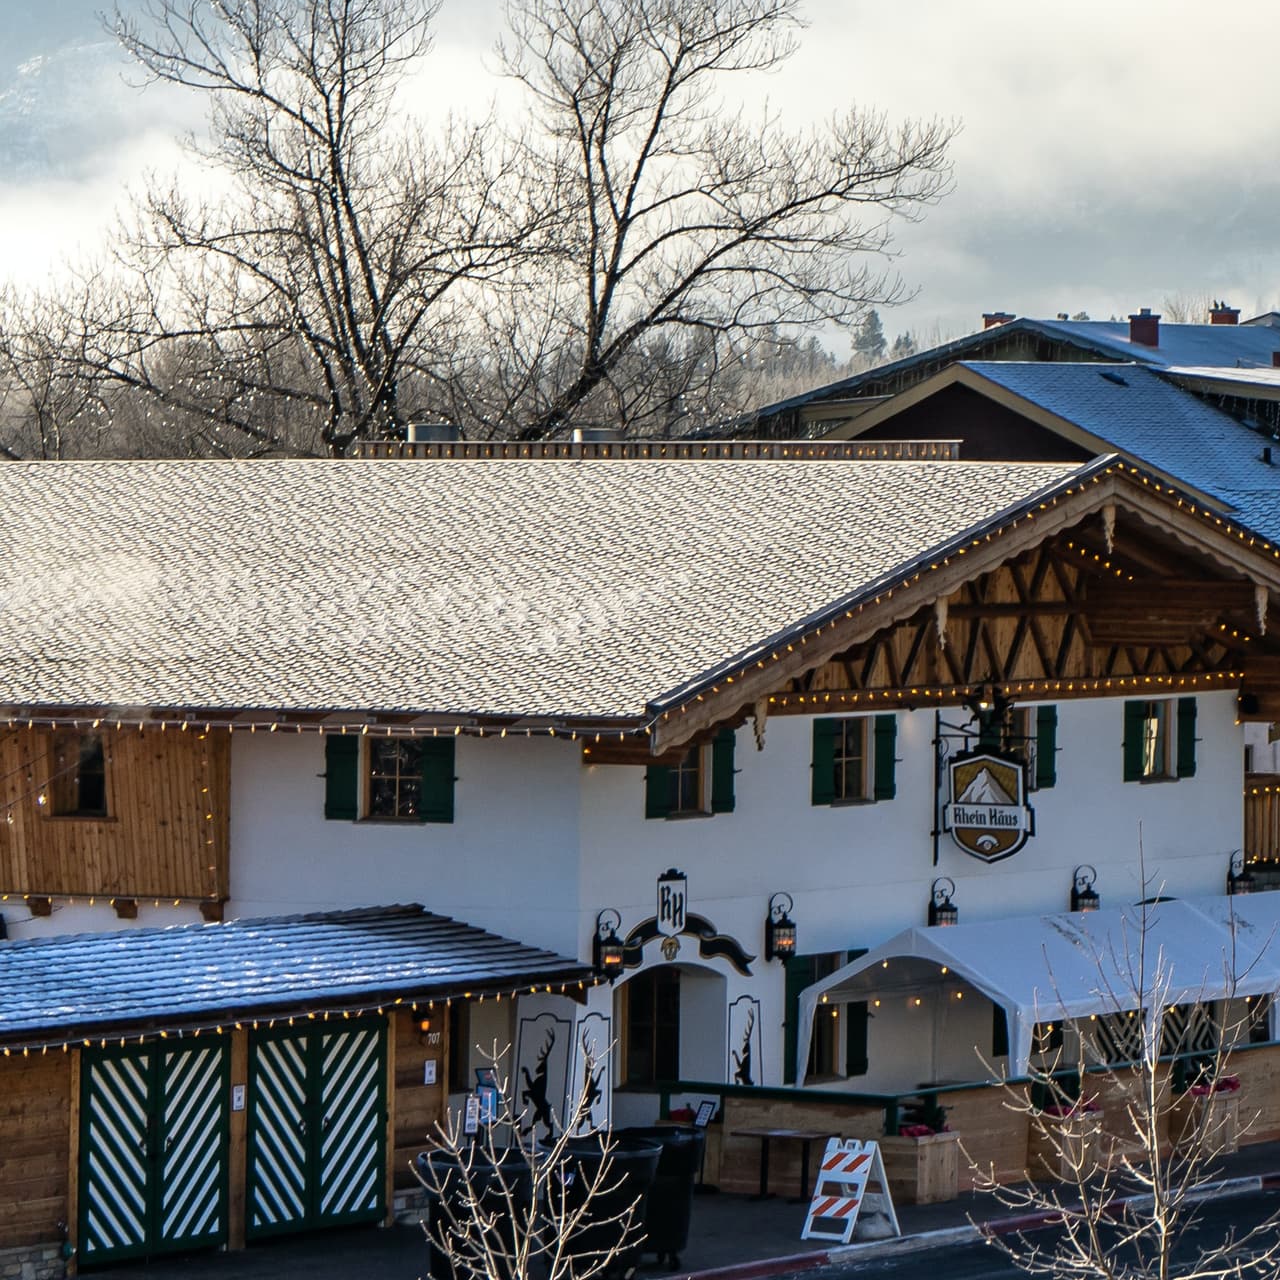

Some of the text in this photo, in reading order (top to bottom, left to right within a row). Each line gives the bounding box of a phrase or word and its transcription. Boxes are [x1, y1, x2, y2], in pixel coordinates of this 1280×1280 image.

[953, 807, 1018, 826] Rhein Häus
[428, 1032, 440, 1045] 707
